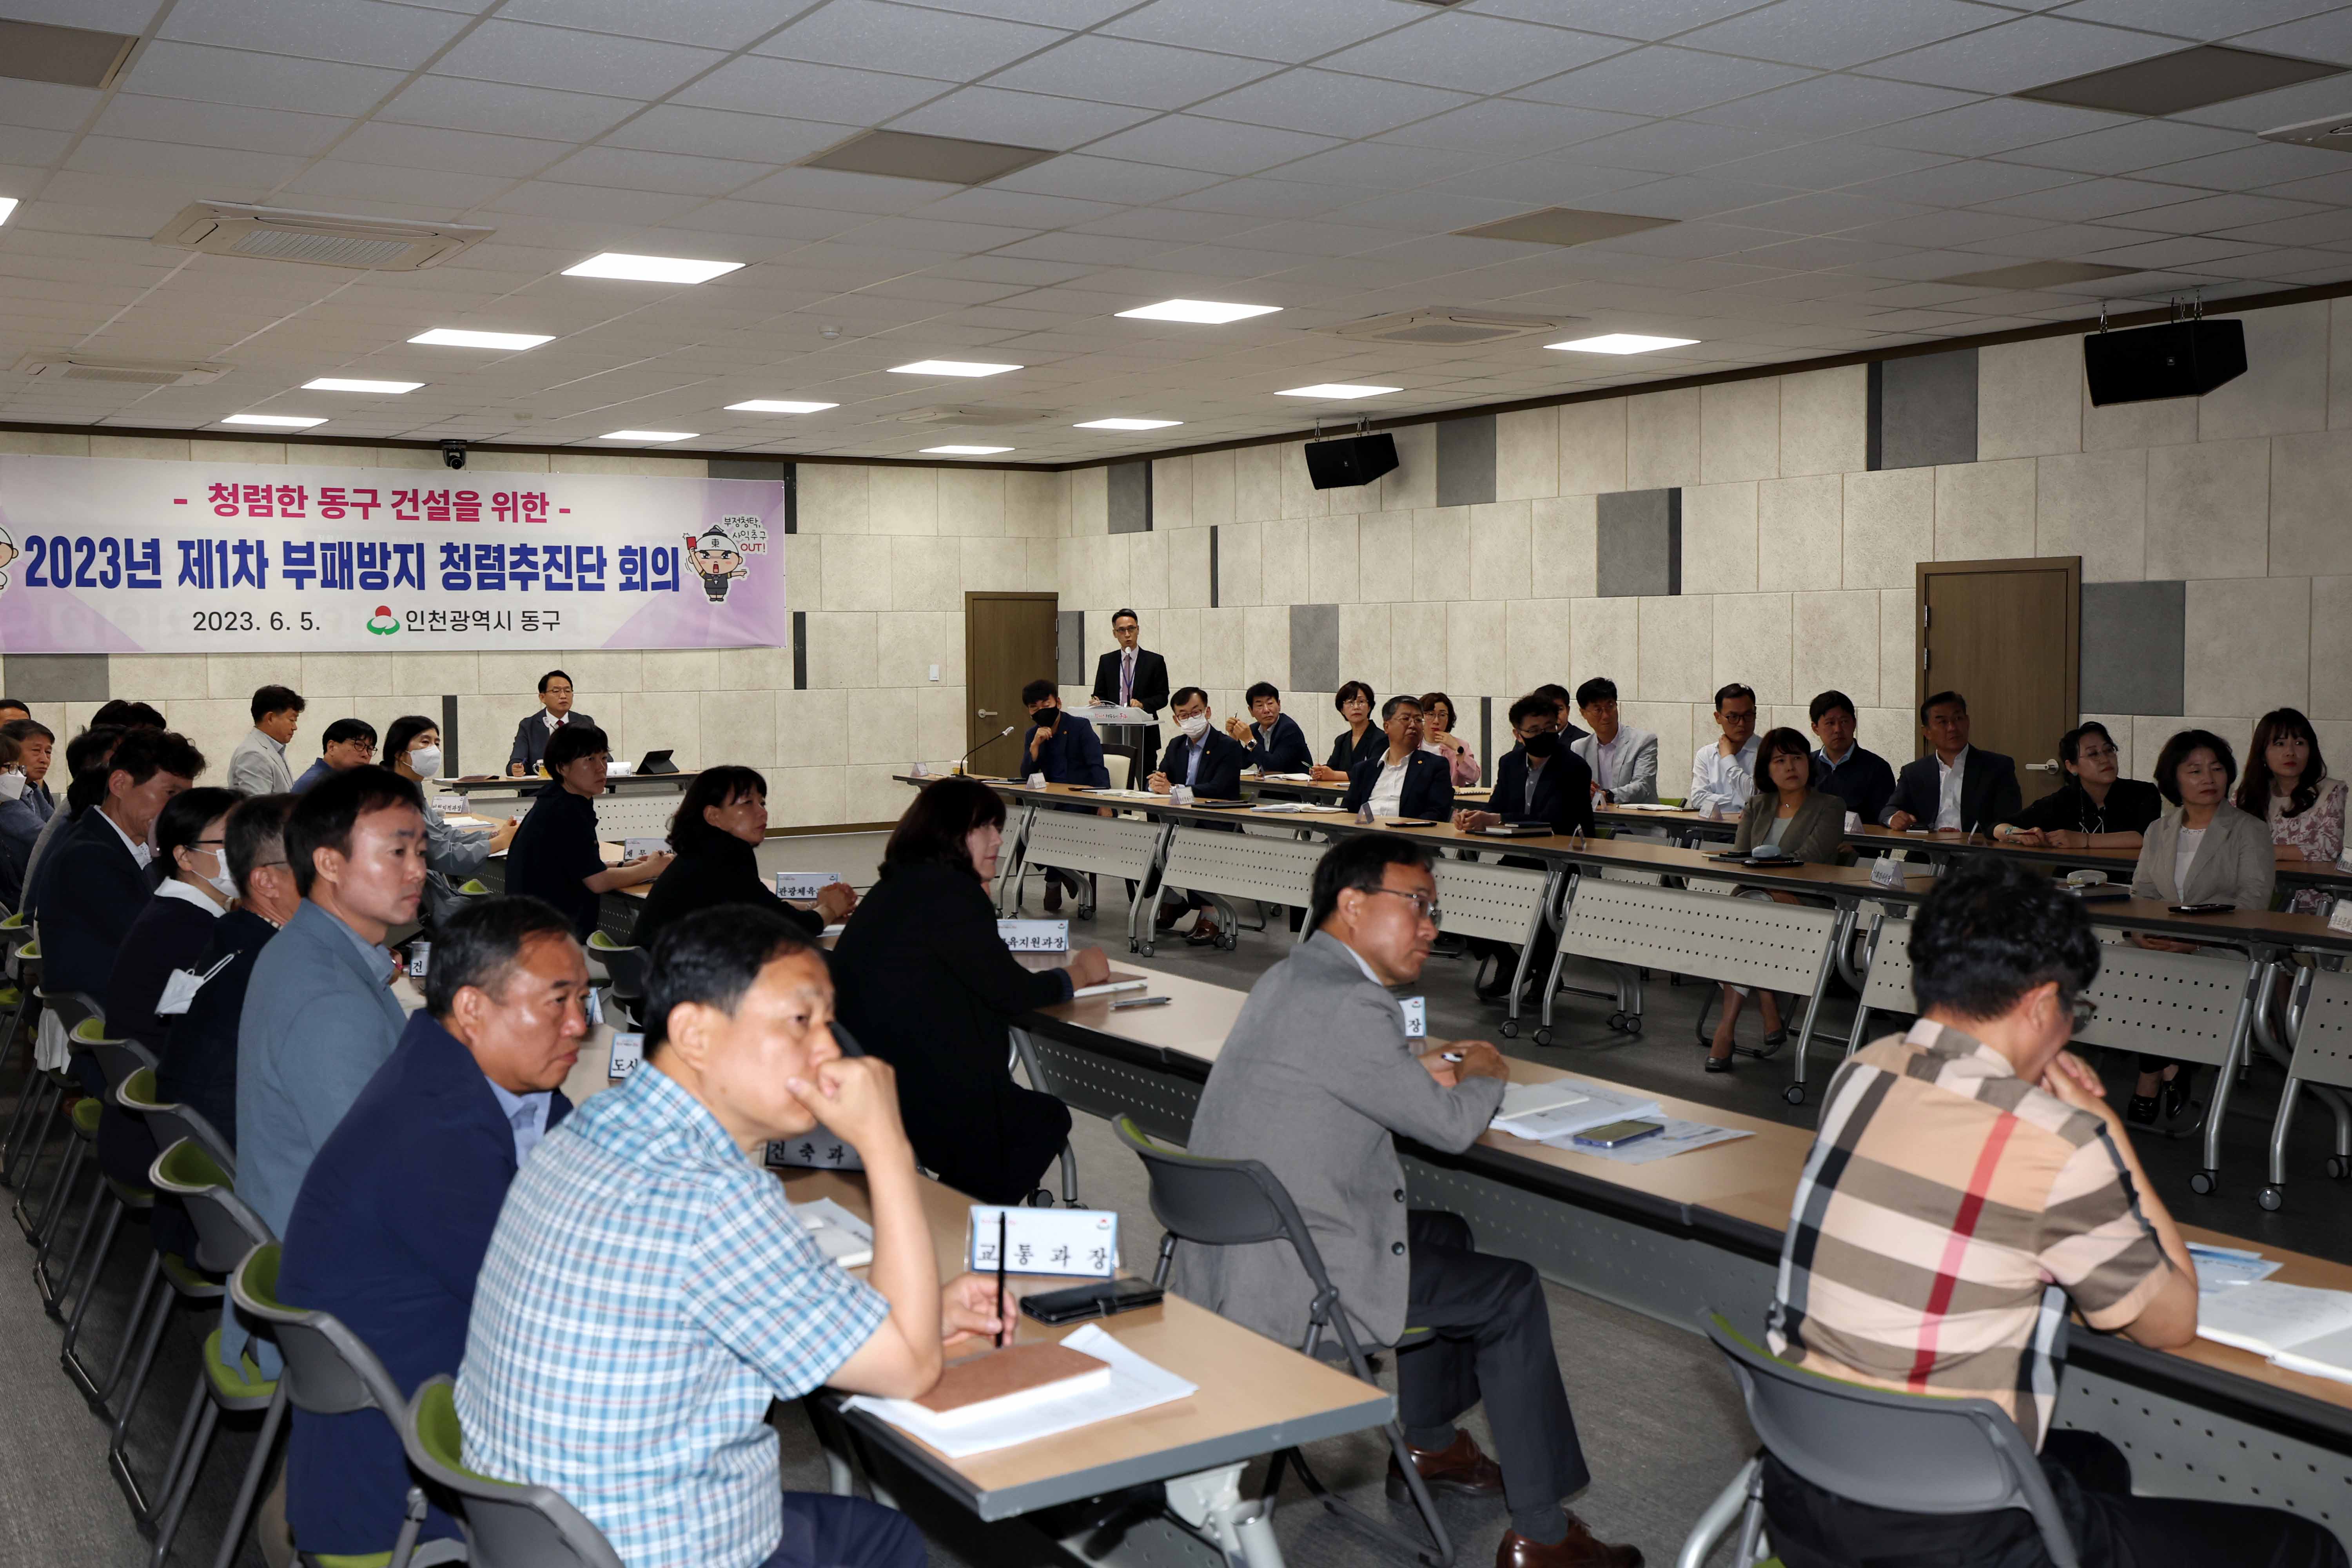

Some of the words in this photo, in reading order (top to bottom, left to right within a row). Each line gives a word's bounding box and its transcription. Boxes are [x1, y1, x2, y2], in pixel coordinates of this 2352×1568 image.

[208, 483, 309, 518] 청렴한
[318, 487, 381, 520] 동구
[391, 488, 482, 522] 건설을
[491, 491, 550, 523] 위한
[724, 516, 761, 528] 부정청탁,
[732, 530, 766, 541] 사익추구
[711, 538, 720, 548] 東
[740, 543, 766, 552] OUT!
[25, 535, 162, 589] 2023년
[178, 539, 269, 589] 제1차
[283, 541, 425, 590] 부패방지
[440, 542, 608, 591] 청렴추진단
[618, 545, 680, 592] 회의
[193, 612, 260, 631] 2023.
[270, 612, 290, 631] 6.
[300, 612, 320, 630] 5.
[406, 610, 511, 632] 인천광역시
[521, 610, 560, 632] 동구
[778, 886, 819, 897] 관광체육
[1001, 936, 1064, 949] 육지원과장
